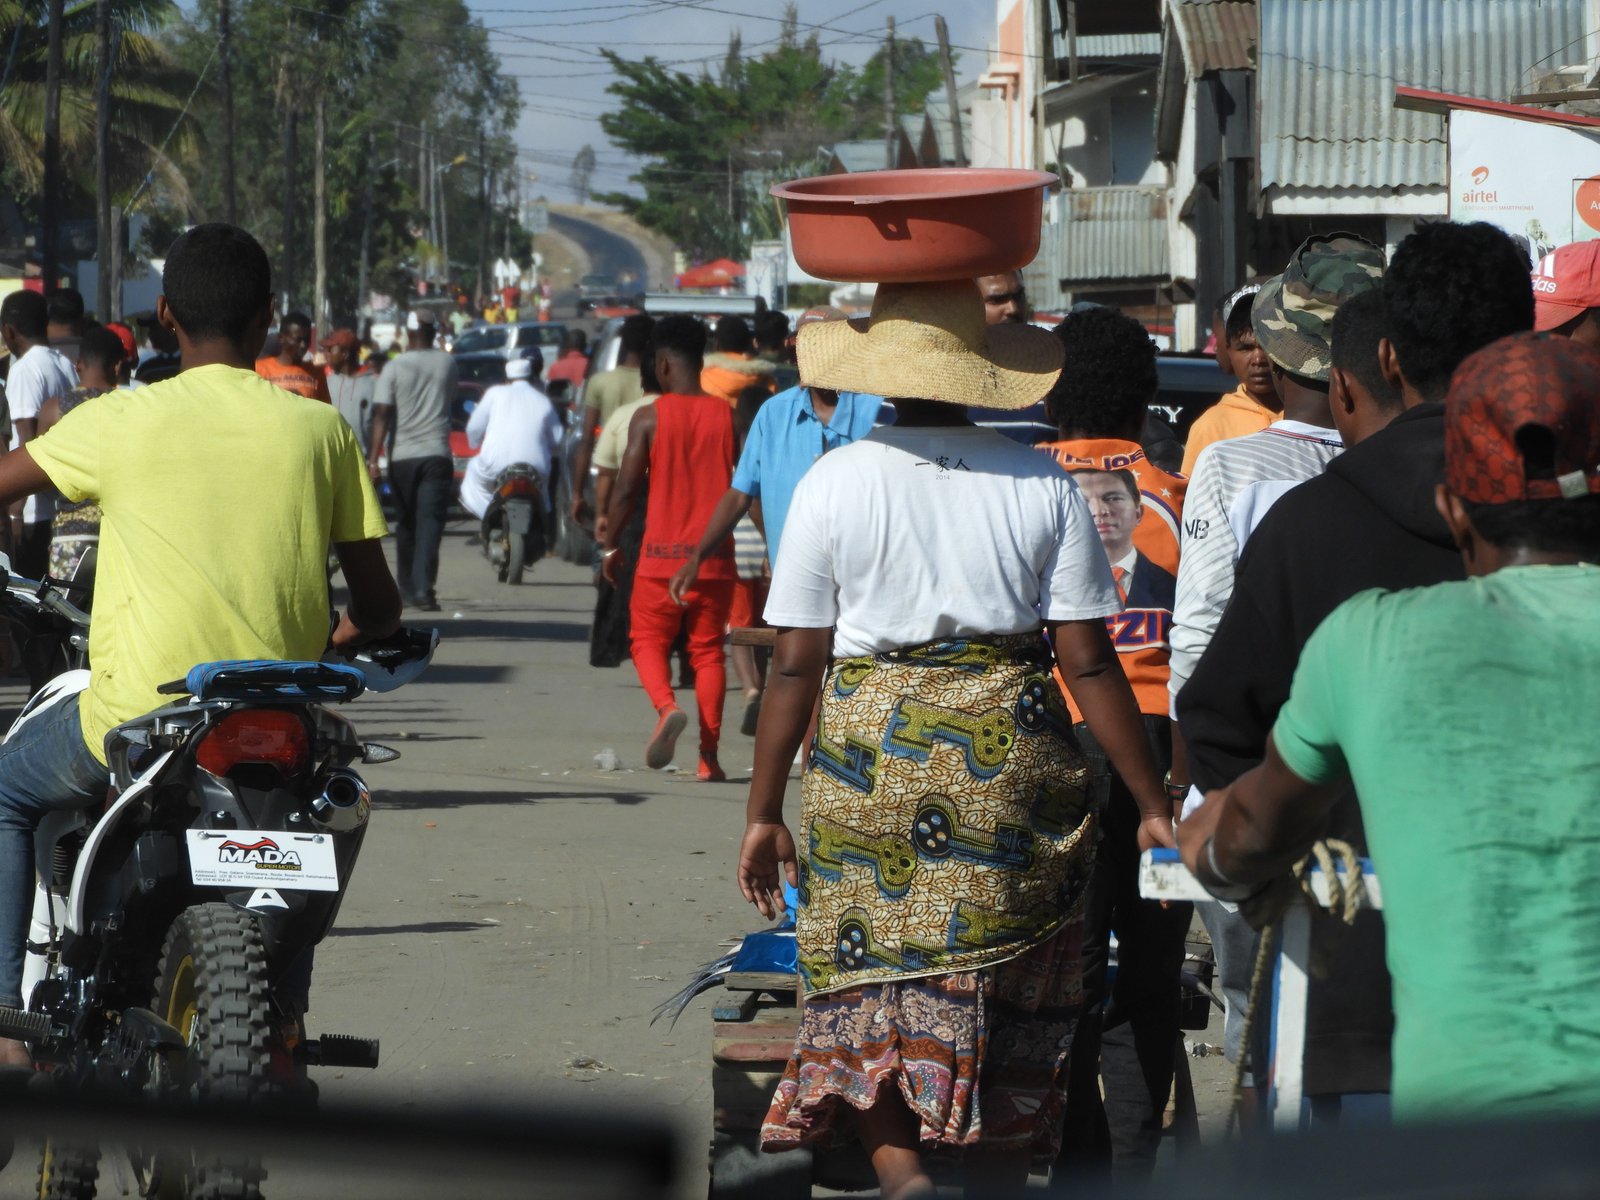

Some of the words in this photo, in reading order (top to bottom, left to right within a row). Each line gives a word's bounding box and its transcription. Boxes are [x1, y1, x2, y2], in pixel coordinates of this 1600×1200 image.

[1462, 189, 1498, 203] airtel
[915, 455, 971, 473] 一家人
[219, 848, 302, 866] MADA
